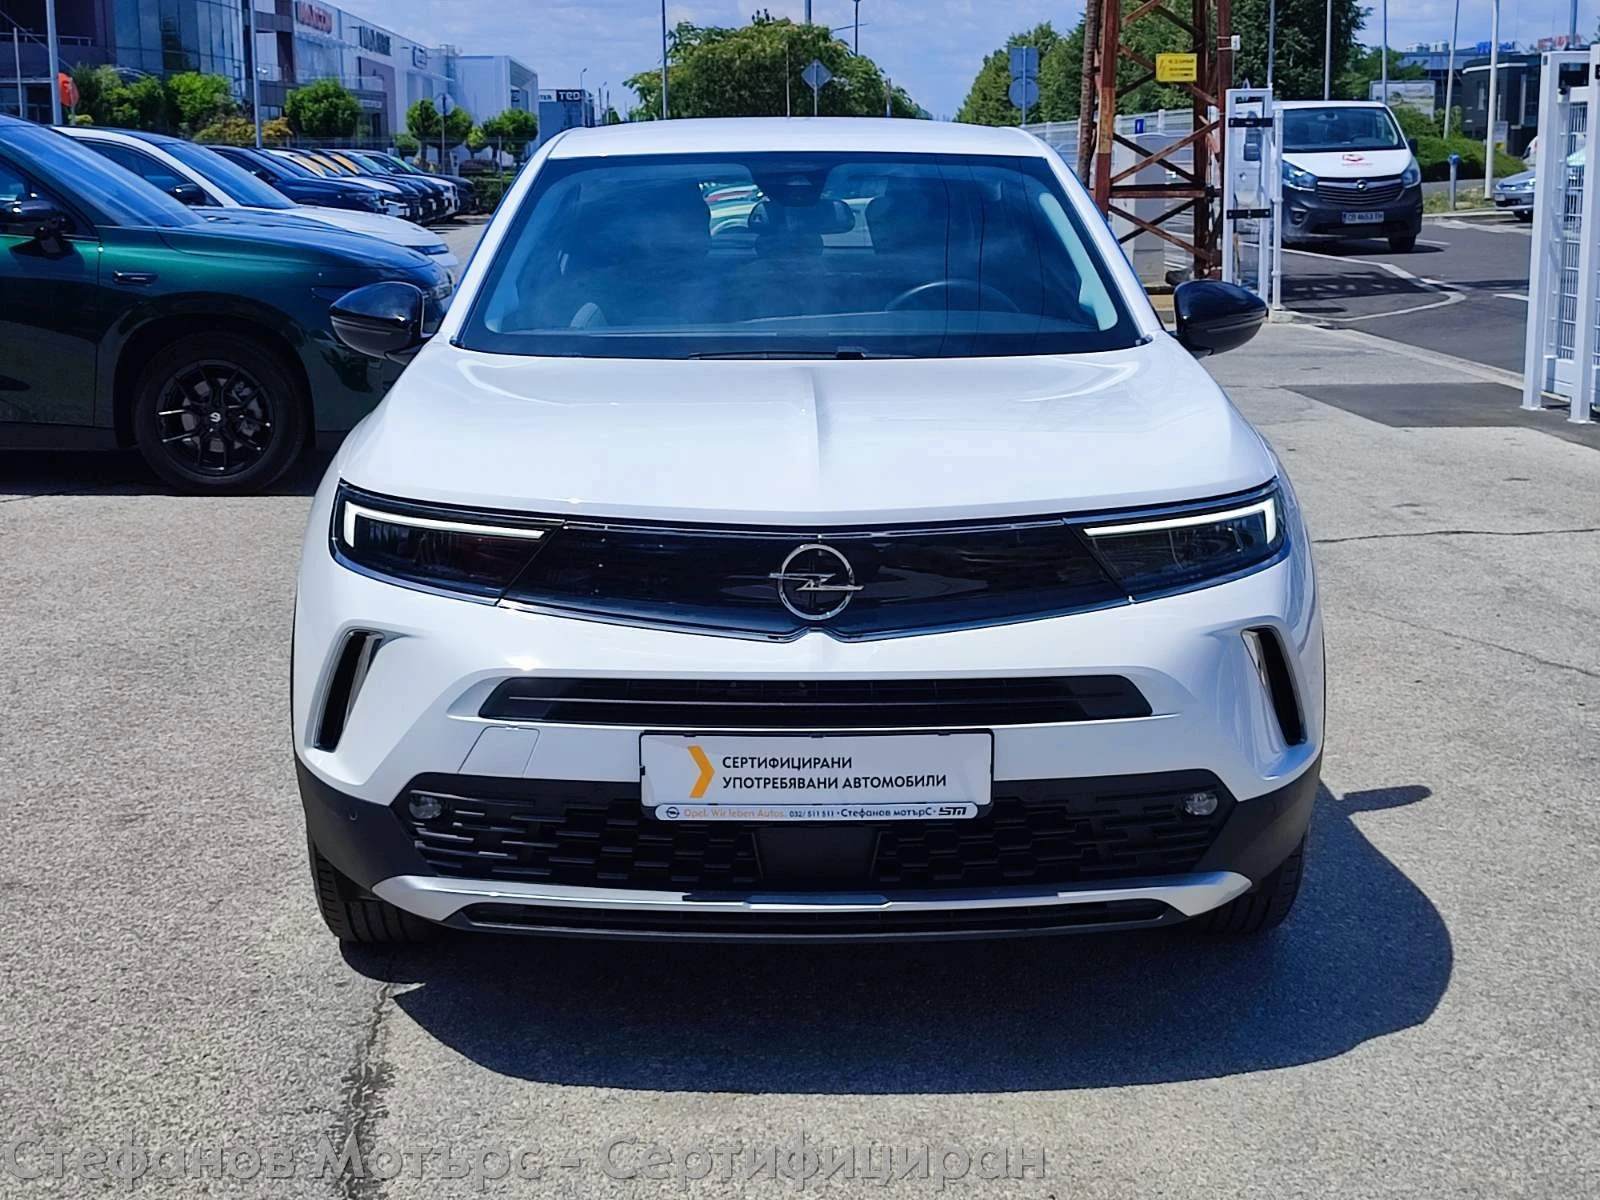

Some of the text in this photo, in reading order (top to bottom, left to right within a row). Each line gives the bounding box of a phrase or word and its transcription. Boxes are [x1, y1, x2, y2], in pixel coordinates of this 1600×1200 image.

[722, 756, 852, 771] СЕРТИФИЦИРАНИ
[722, 774, 947, 789] УПОТРЕБЯВАНИ АВТОМОБИЛИ
